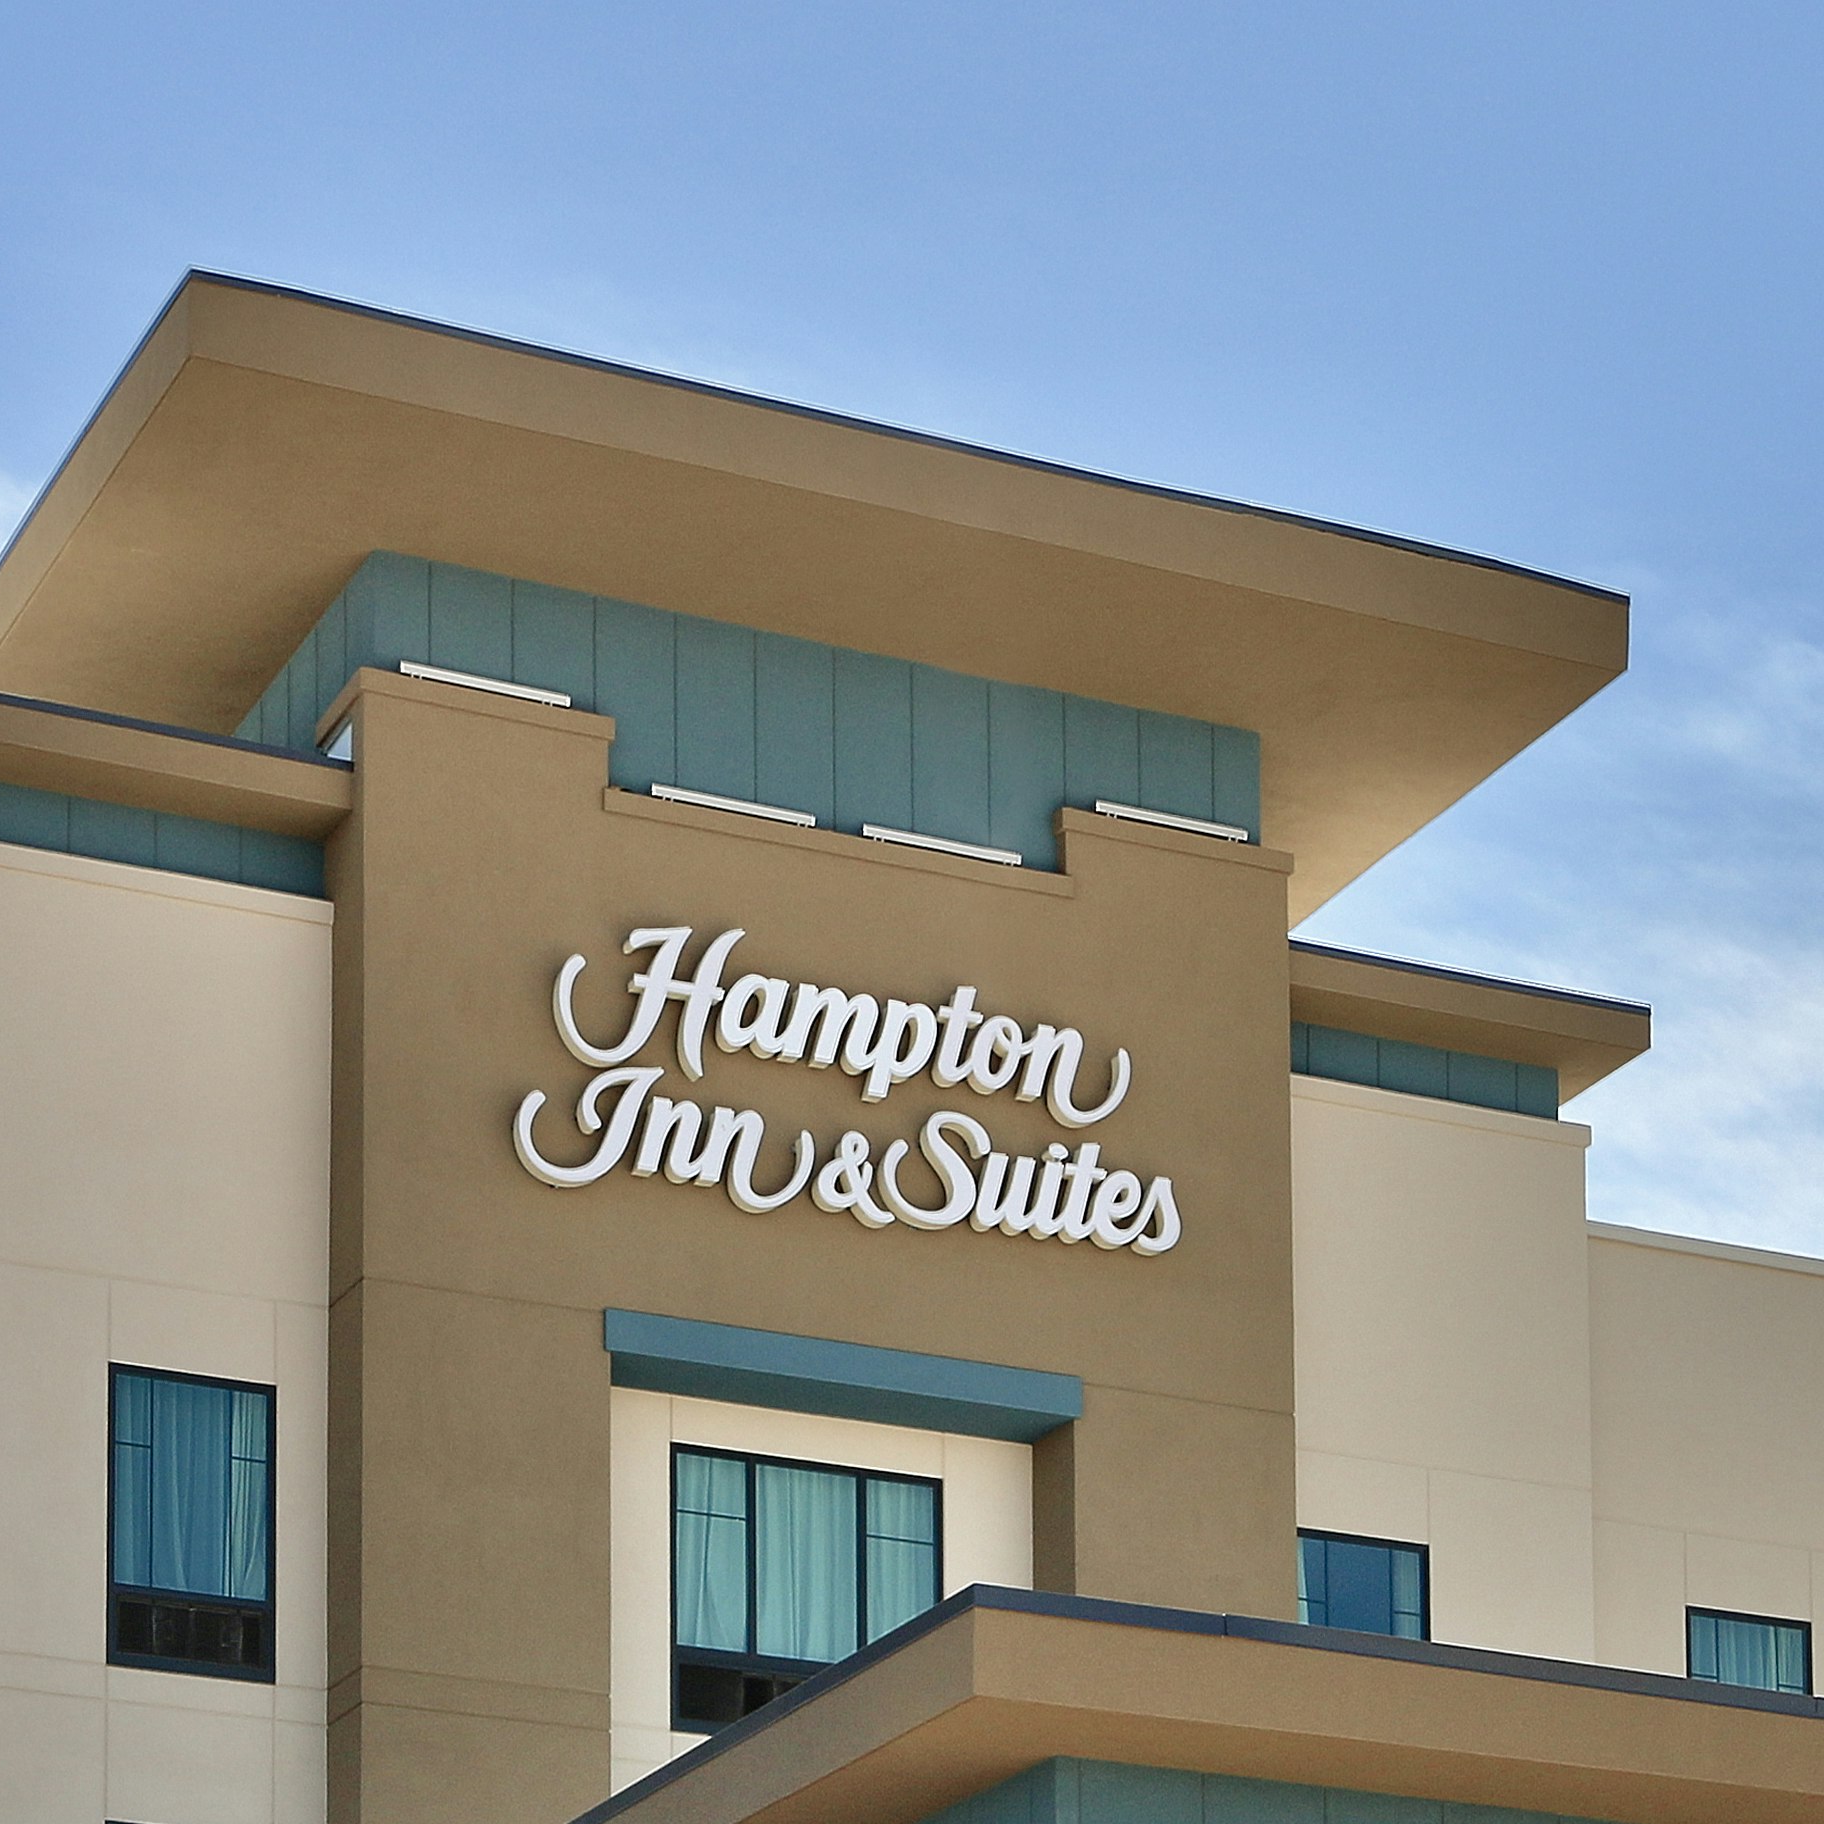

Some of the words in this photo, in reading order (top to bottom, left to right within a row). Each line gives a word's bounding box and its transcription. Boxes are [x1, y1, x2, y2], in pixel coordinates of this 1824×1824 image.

[553, 926, 1131, 1128] Hampton
[513, 1066, 814, 1214] Inn
[812, 1131, 895, 1229] &
[881, 1111, 1182, 1257] Suites
